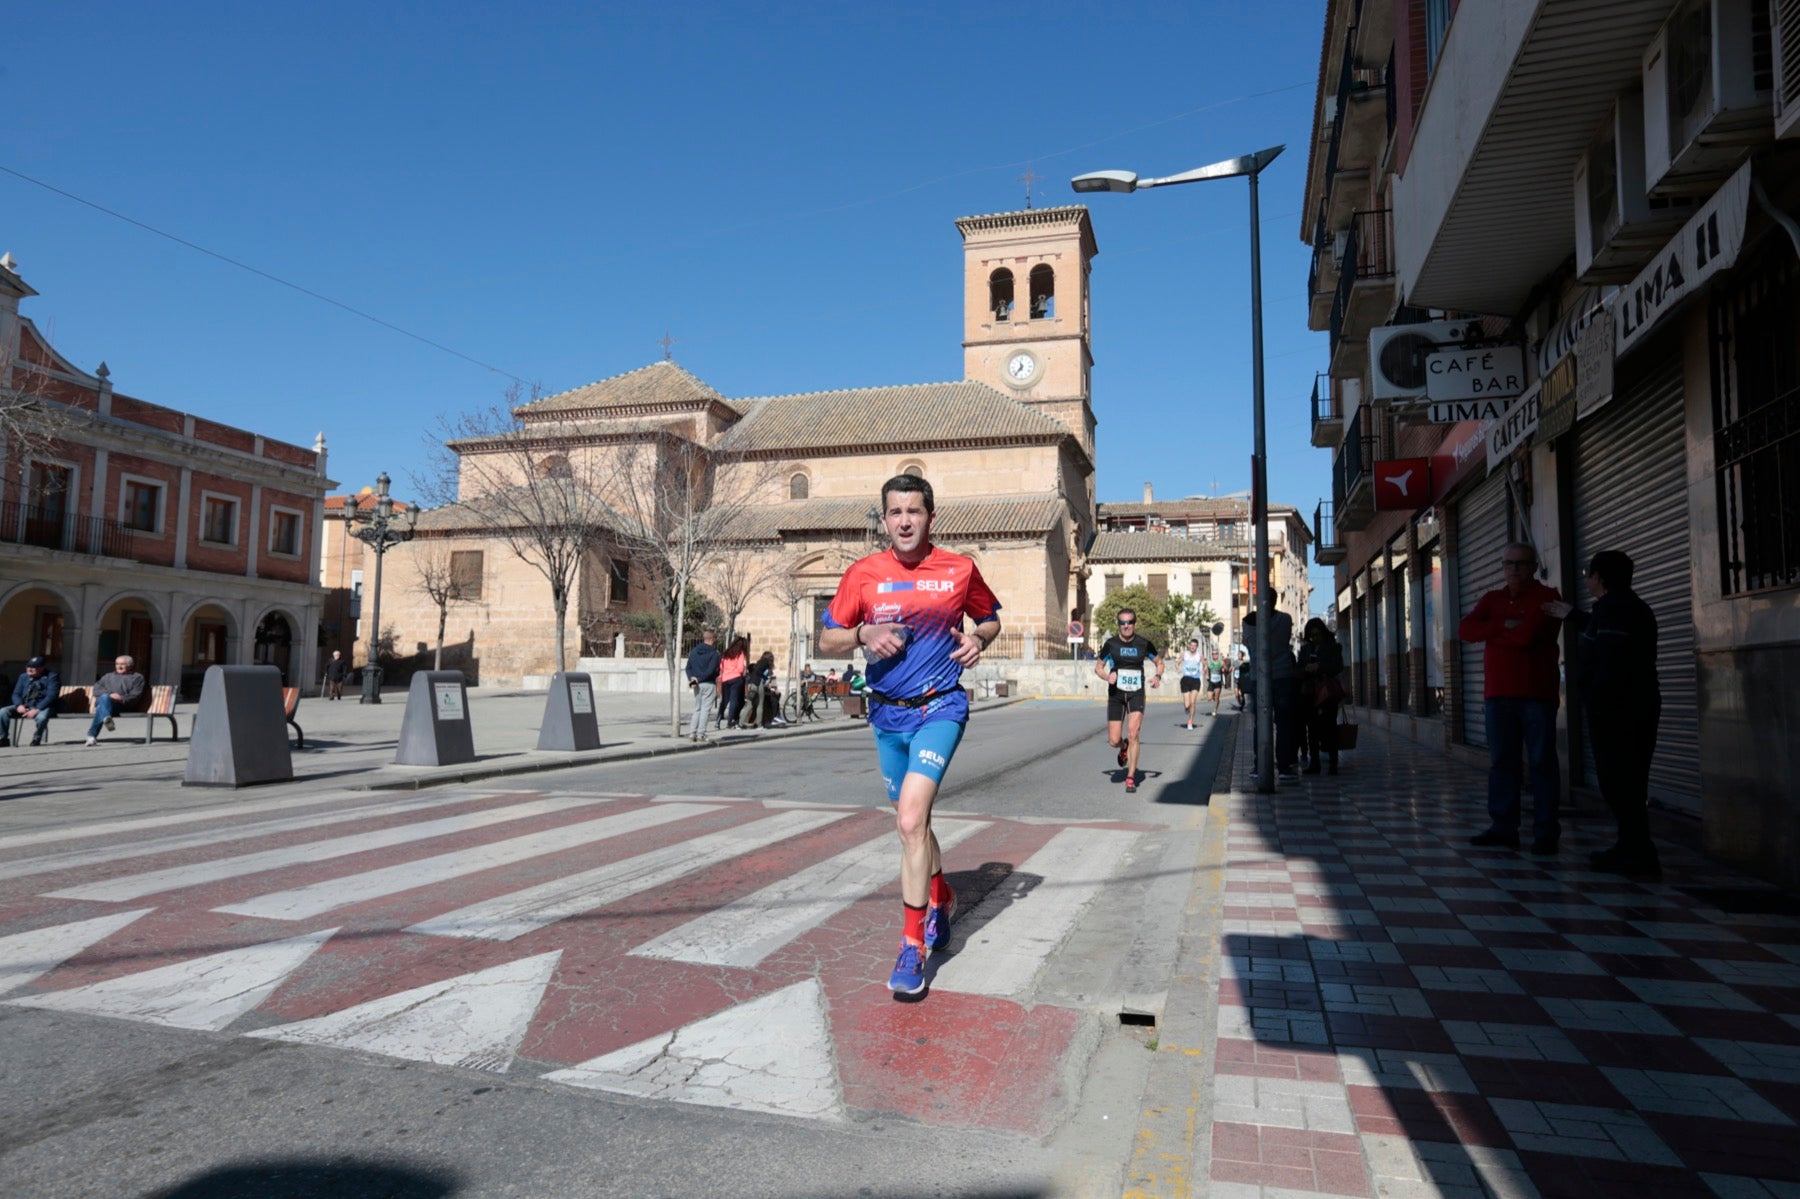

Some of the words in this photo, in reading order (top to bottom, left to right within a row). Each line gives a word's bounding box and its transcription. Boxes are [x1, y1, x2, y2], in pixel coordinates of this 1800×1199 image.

[1622, 253, 1685, 339] LIMA
[1696, 210, 1720, 270] II
[1430, 352, 1495, 374] CAFÉ
[1472, 375, 1520, 393] BAR
[1433, 401, 1499, 422] LIMA
[916, 579, 954, 592] SEUR
[1122, 676, 1138, 685] 582
[918, 749, 945, 767] SEUR
